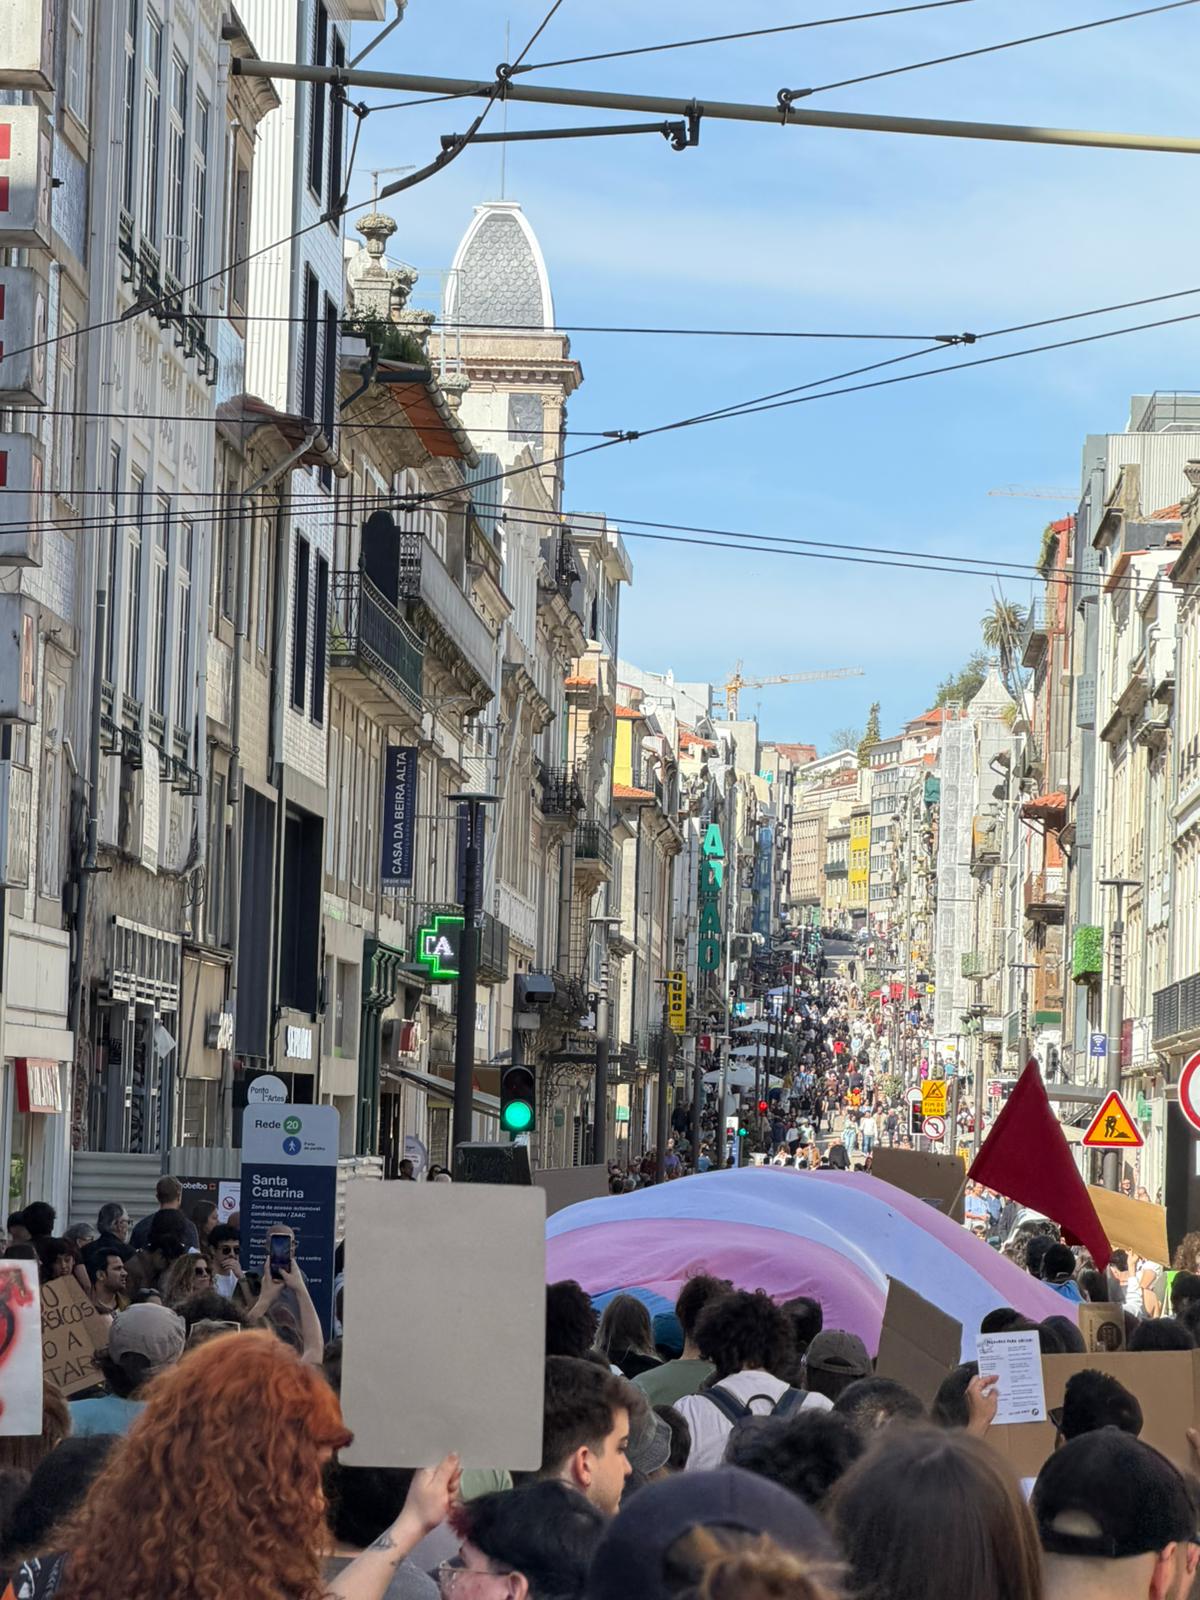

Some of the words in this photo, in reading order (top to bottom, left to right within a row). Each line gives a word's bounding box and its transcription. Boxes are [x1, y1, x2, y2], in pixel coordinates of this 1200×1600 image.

[396, 751, 407, 782] ALTA
[394, 783, 405, 819] BEIRA
[393, 822, 404, 839] DA
[392, 841, 403, 874] CASA
[251, 1087, 269, 1096] Ponto
[255, 1119, 281, 1129] Rede
[286, 1120, 299, 1130] 20
[183, 1182, 207, 1190] obelba
[252, 1174, 288, 1186] Santa
[252, 1186, 304, 1198] Catarina
[41, 1301, 94, 1334] ÁSICOS
[41, 1340, 58, 1360] O
[68, 1331, 83, 1351] A
[43, 1355, 98, 1387] TAR
